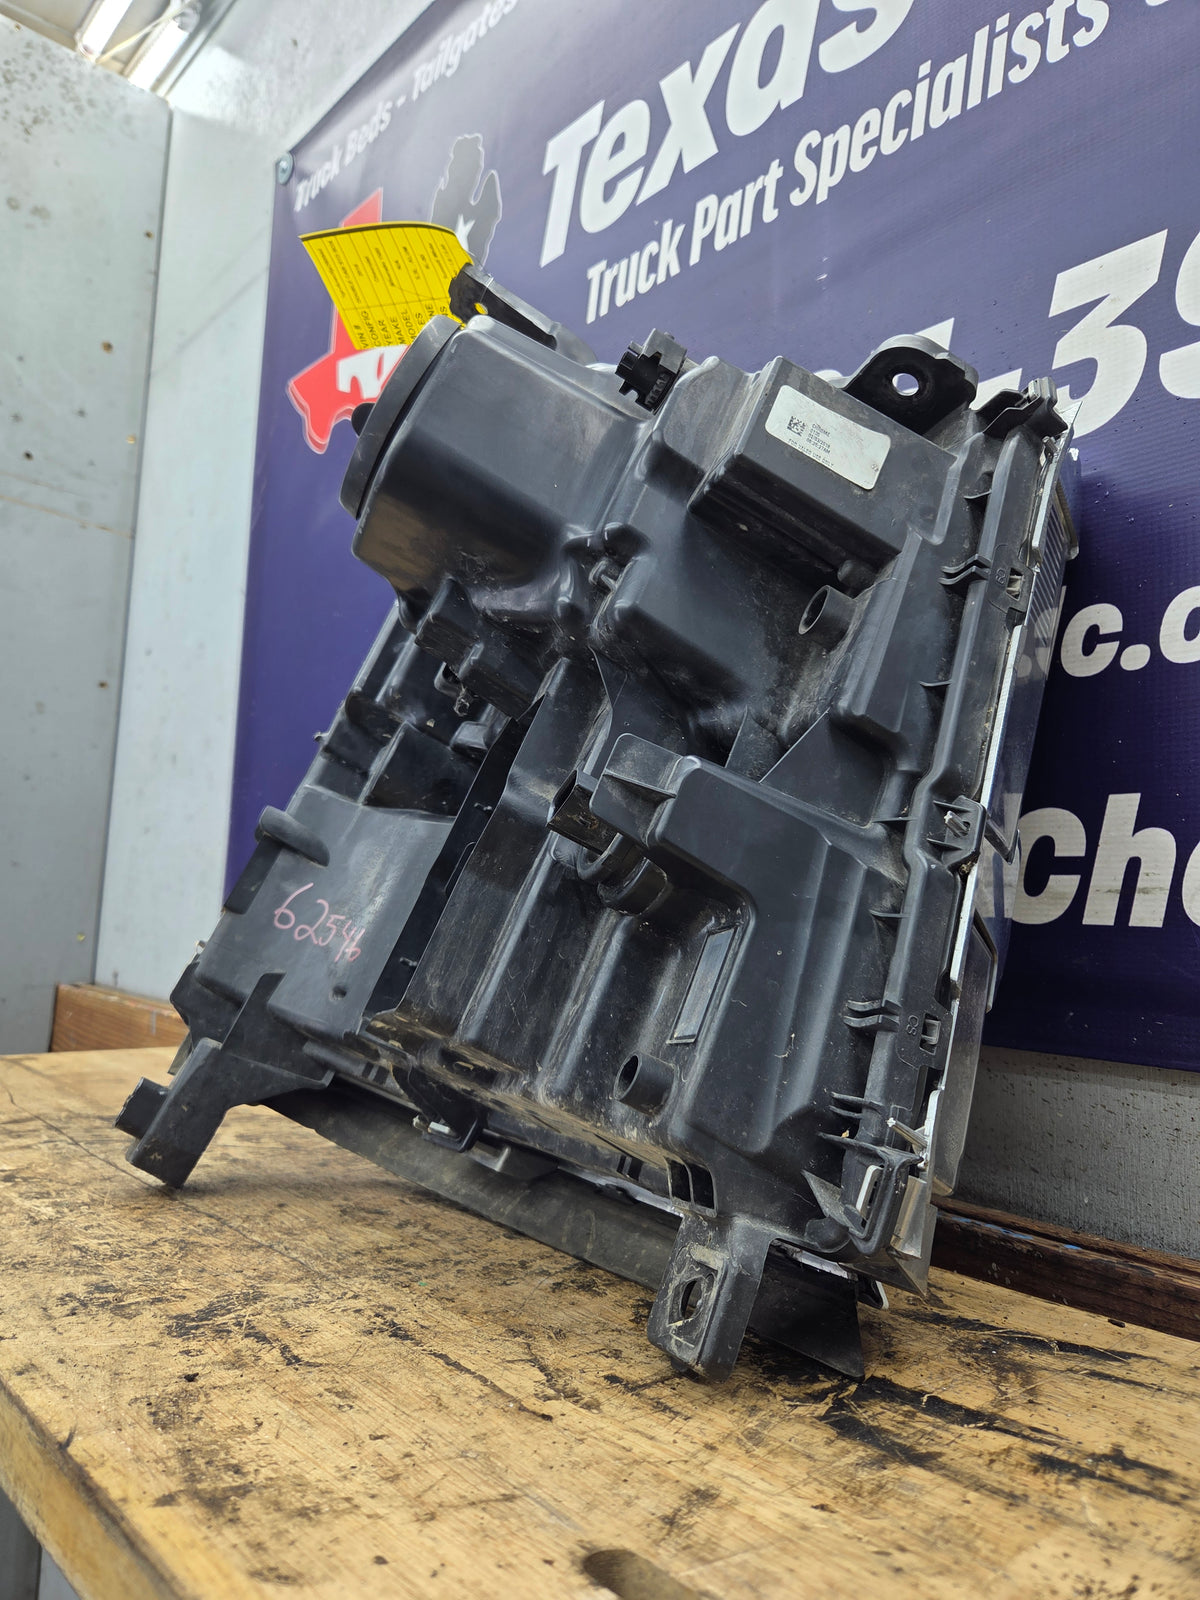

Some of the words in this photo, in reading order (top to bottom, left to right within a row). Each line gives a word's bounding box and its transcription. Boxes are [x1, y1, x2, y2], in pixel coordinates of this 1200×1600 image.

[586, 218, 685, 325] Truck
[689, 159, 783, 267] Part
[789, 0, 1109, 206] Specialists
